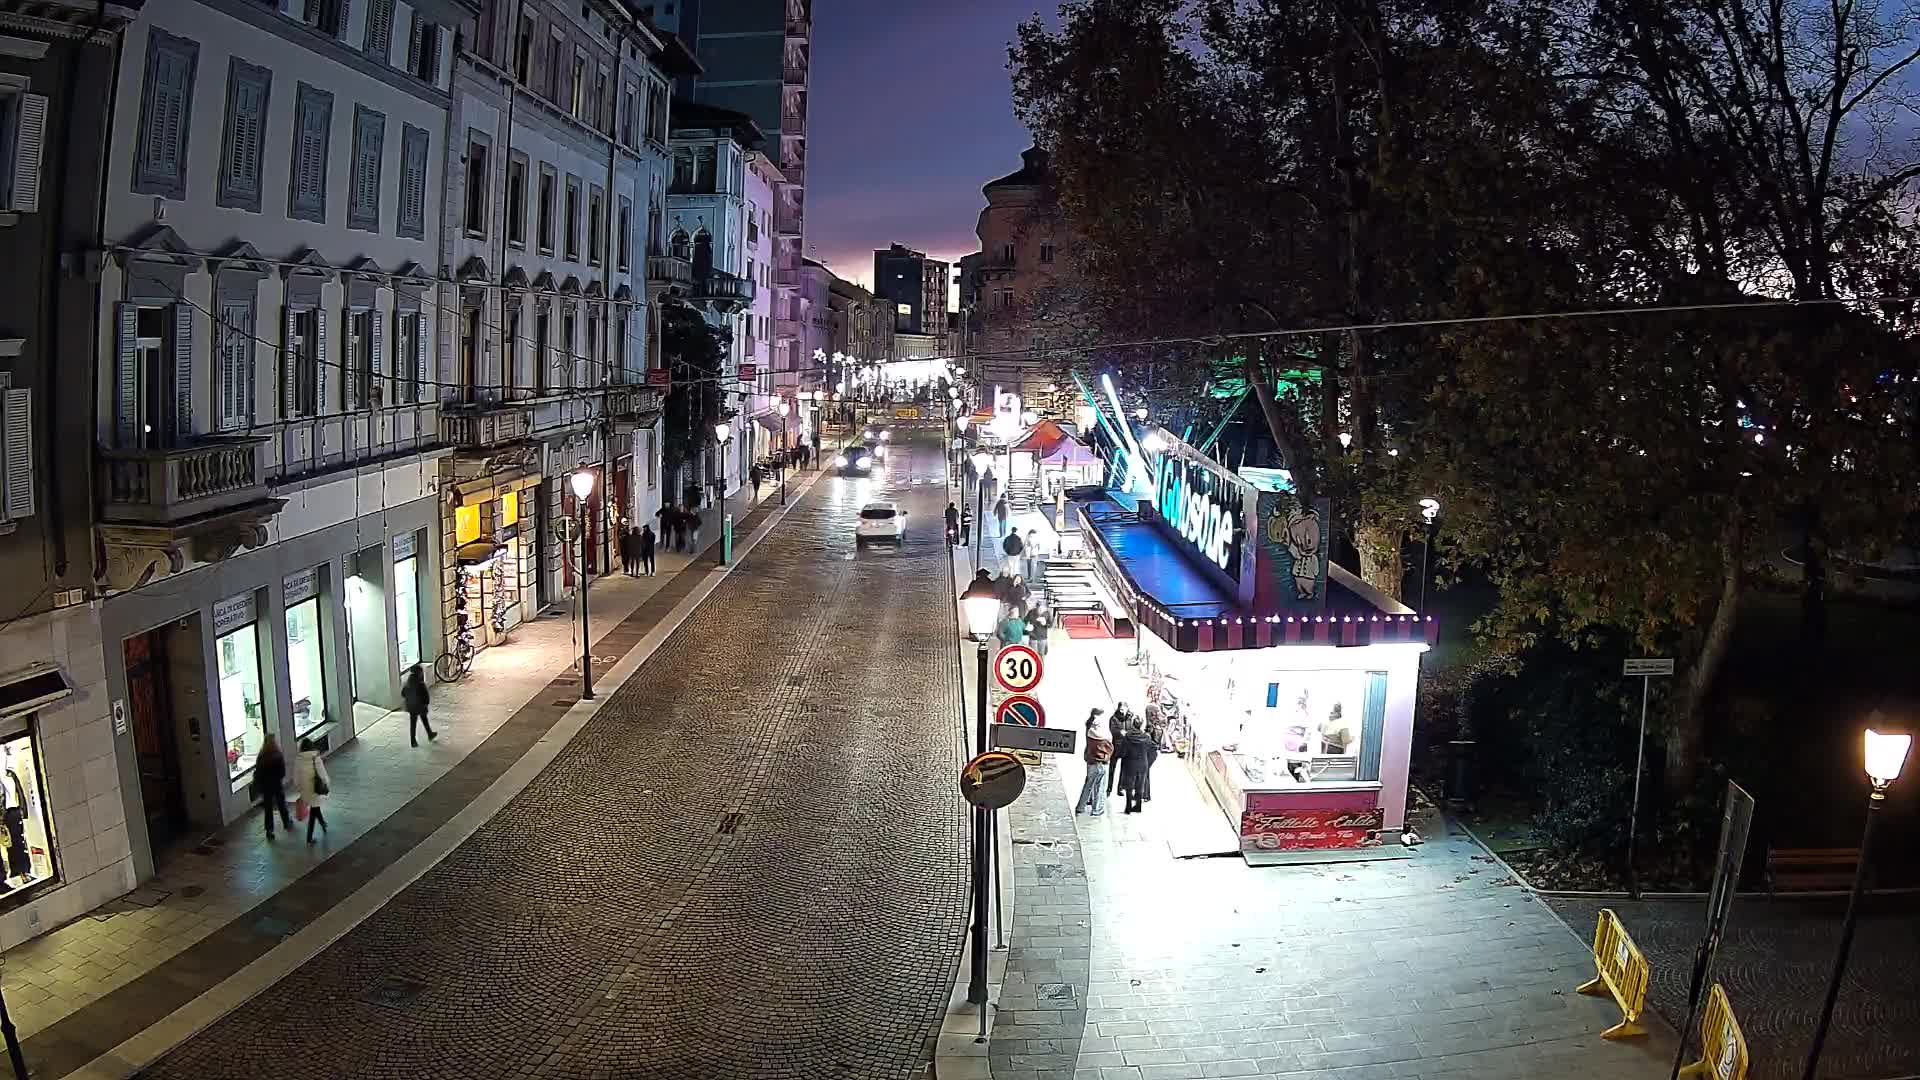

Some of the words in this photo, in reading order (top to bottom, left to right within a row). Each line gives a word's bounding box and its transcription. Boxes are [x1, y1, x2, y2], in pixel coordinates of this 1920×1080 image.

[1161, 458, 1233, 570] Golosone
[1005, 658, 1033, 680] 30
[1038, 737, 1070, 749] Dante
